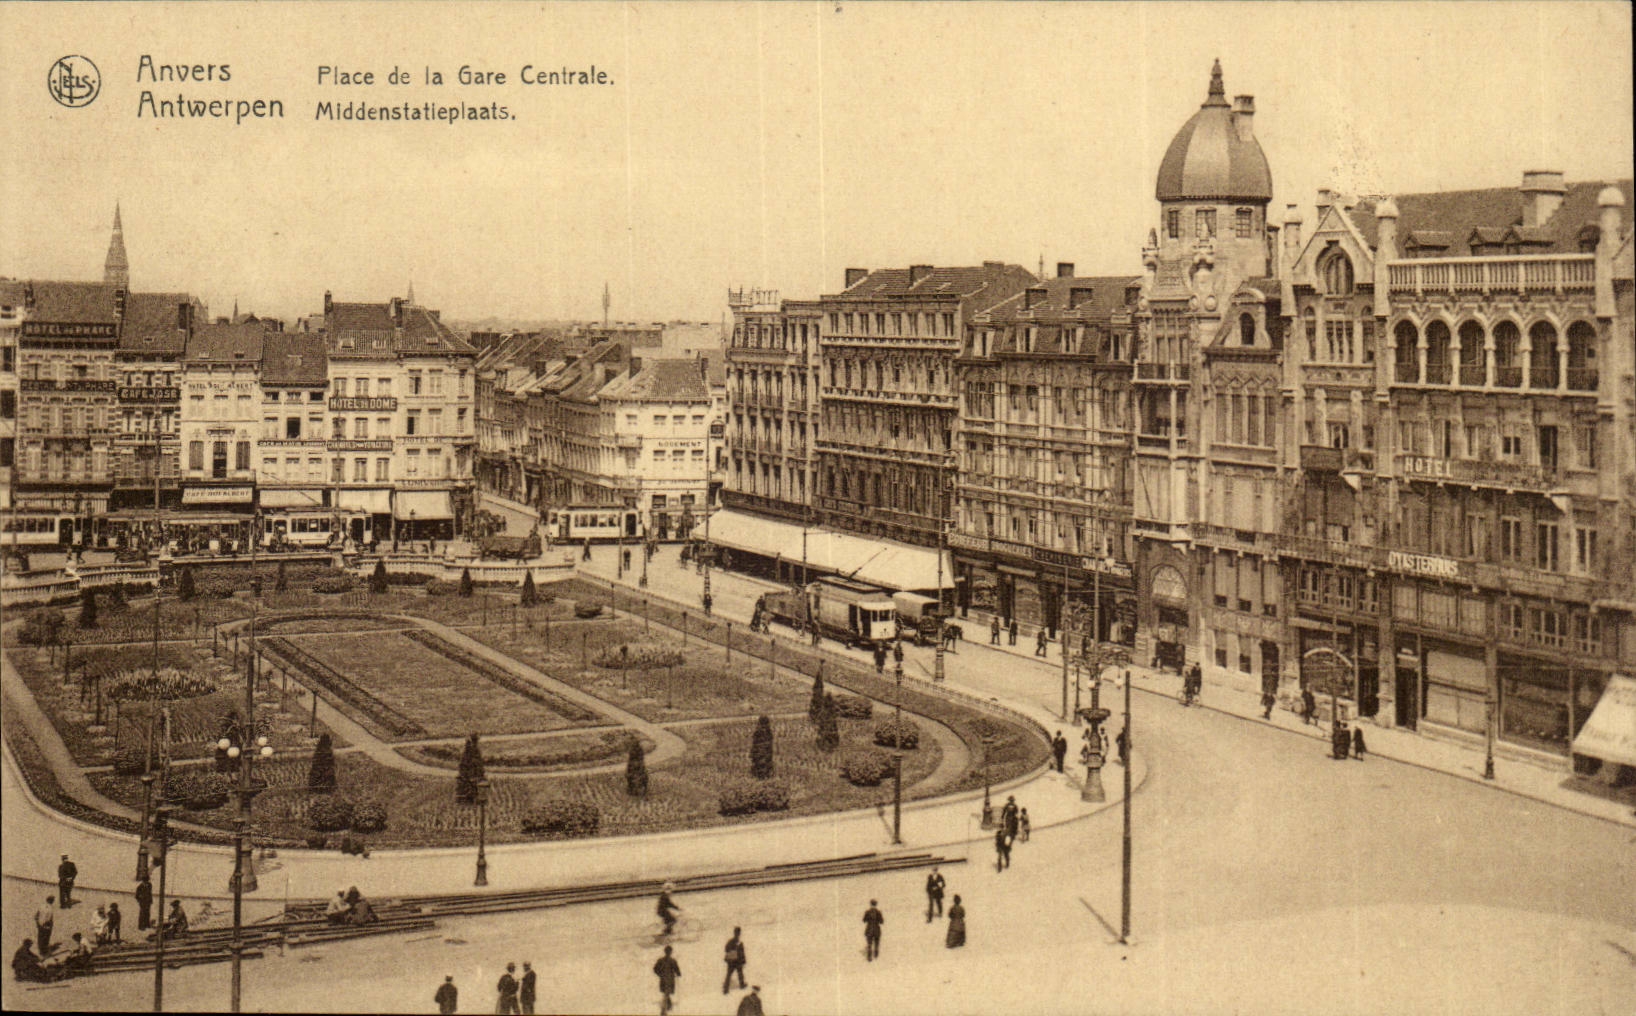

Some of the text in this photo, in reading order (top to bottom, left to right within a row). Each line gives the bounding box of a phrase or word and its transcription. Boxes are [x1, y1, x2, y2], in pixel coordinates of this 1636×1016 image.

[25, 324, 62, 335] HOTEL
[85, 381, 114, 391] PHARE
[330, 398, 360, 409] HOTEL
[370, 399, 397, 409] DOME
[1405, 457, 1454, 478] HOTEL
